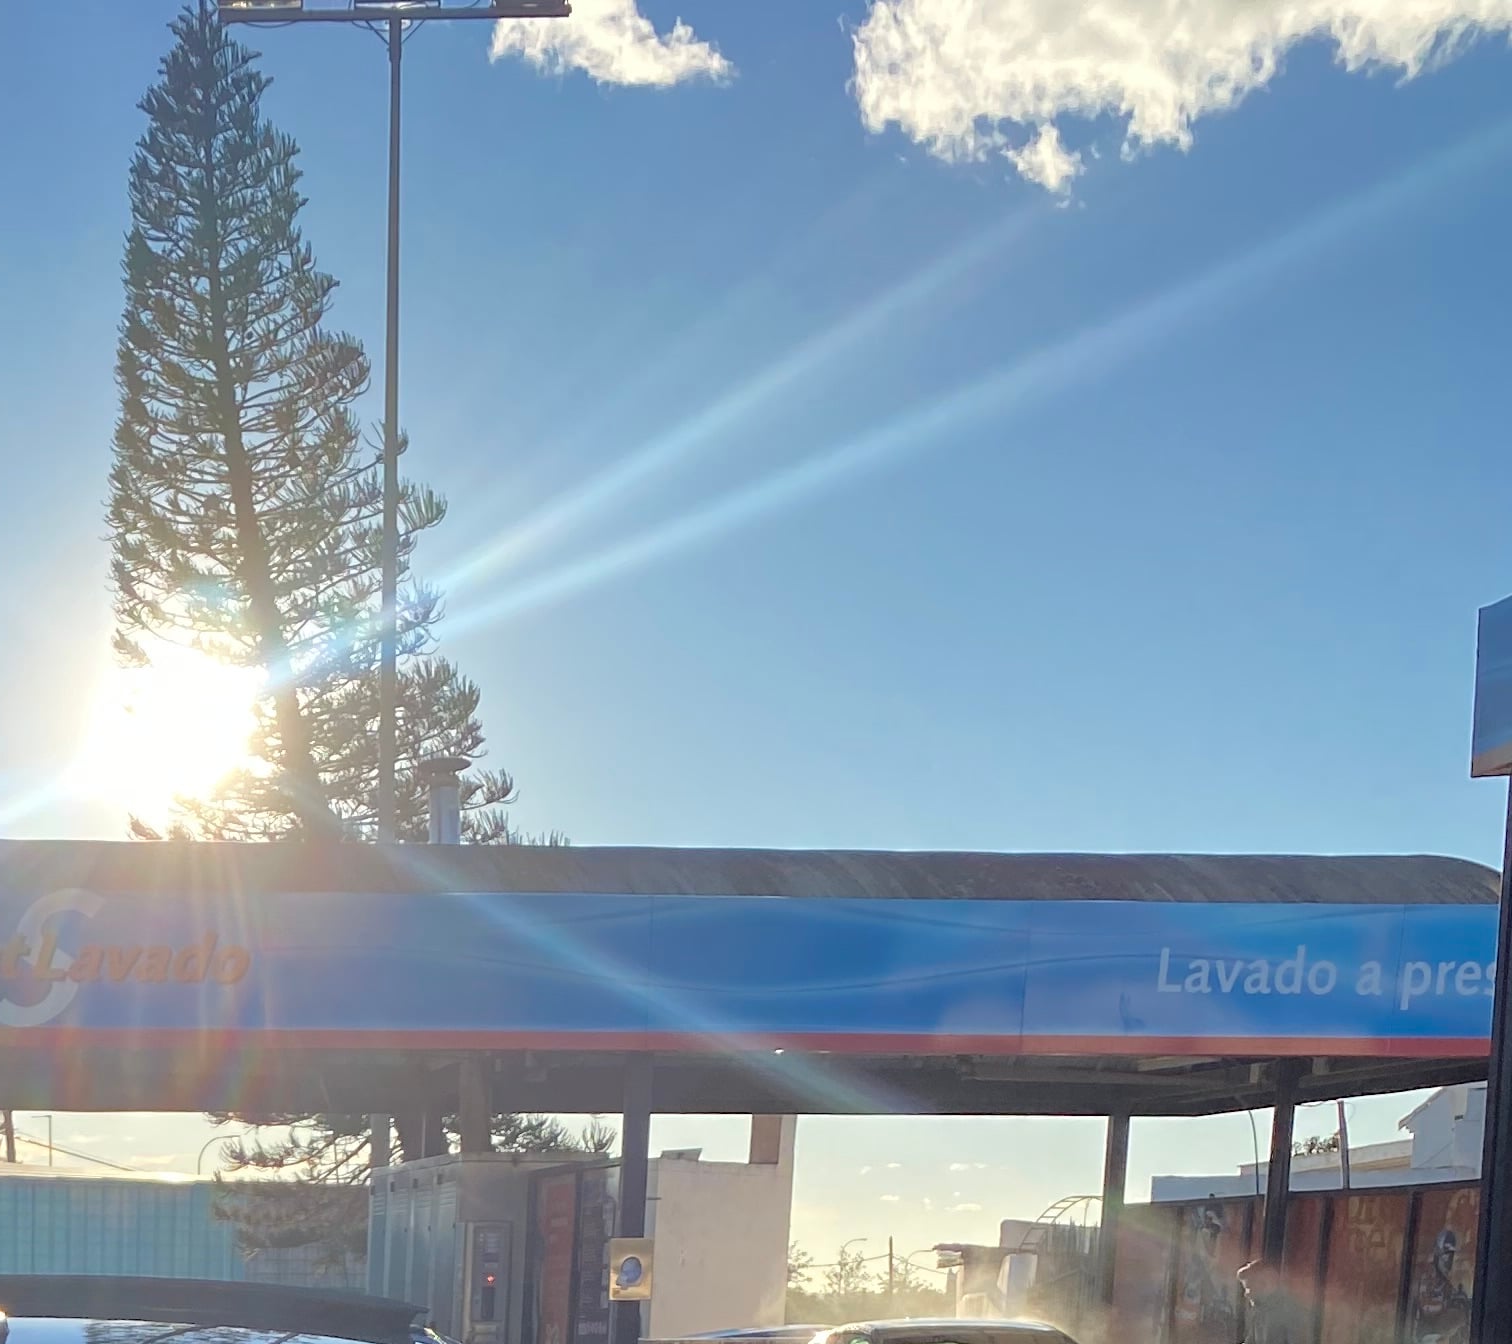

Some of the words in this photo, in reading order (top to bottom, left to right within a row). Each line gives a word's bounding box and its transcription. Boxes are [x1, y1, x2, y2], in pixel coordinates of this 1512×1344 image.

[34, 928, 252, 986] Lavado
[1156, 943, 1338, 995] Lavado
[1355, 960, 1383, 996] a
